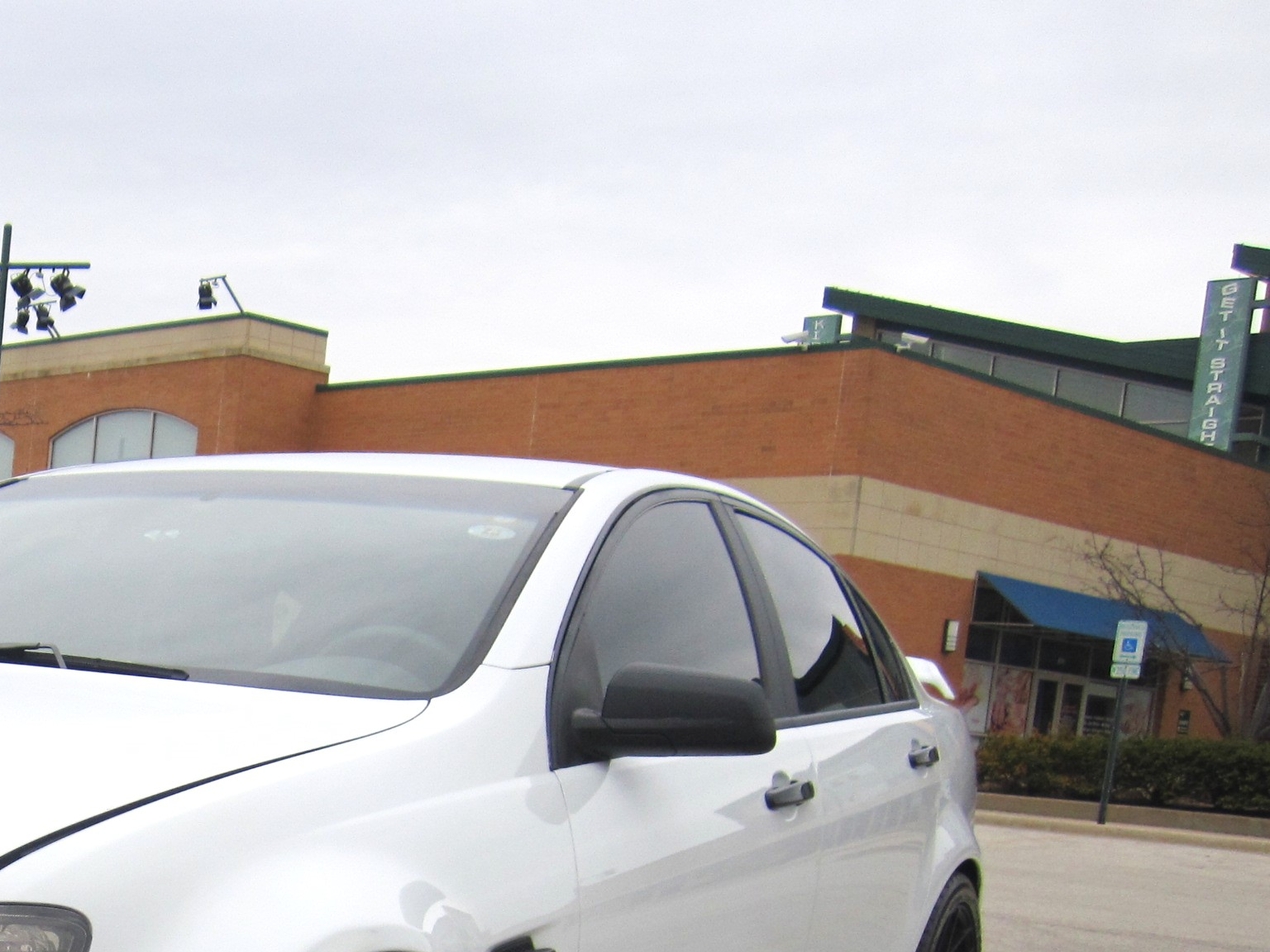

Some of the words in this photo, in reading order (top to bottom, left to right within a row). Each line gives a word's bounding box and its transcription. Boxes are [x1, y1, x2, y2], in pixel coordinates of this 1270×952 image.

[1219, 282, 1238, 322] GET
[811, 319, 825, 345] KI
[1215, 328, 1229, 351] IT
[1199, 358, 1226, 446] STRAIGH
